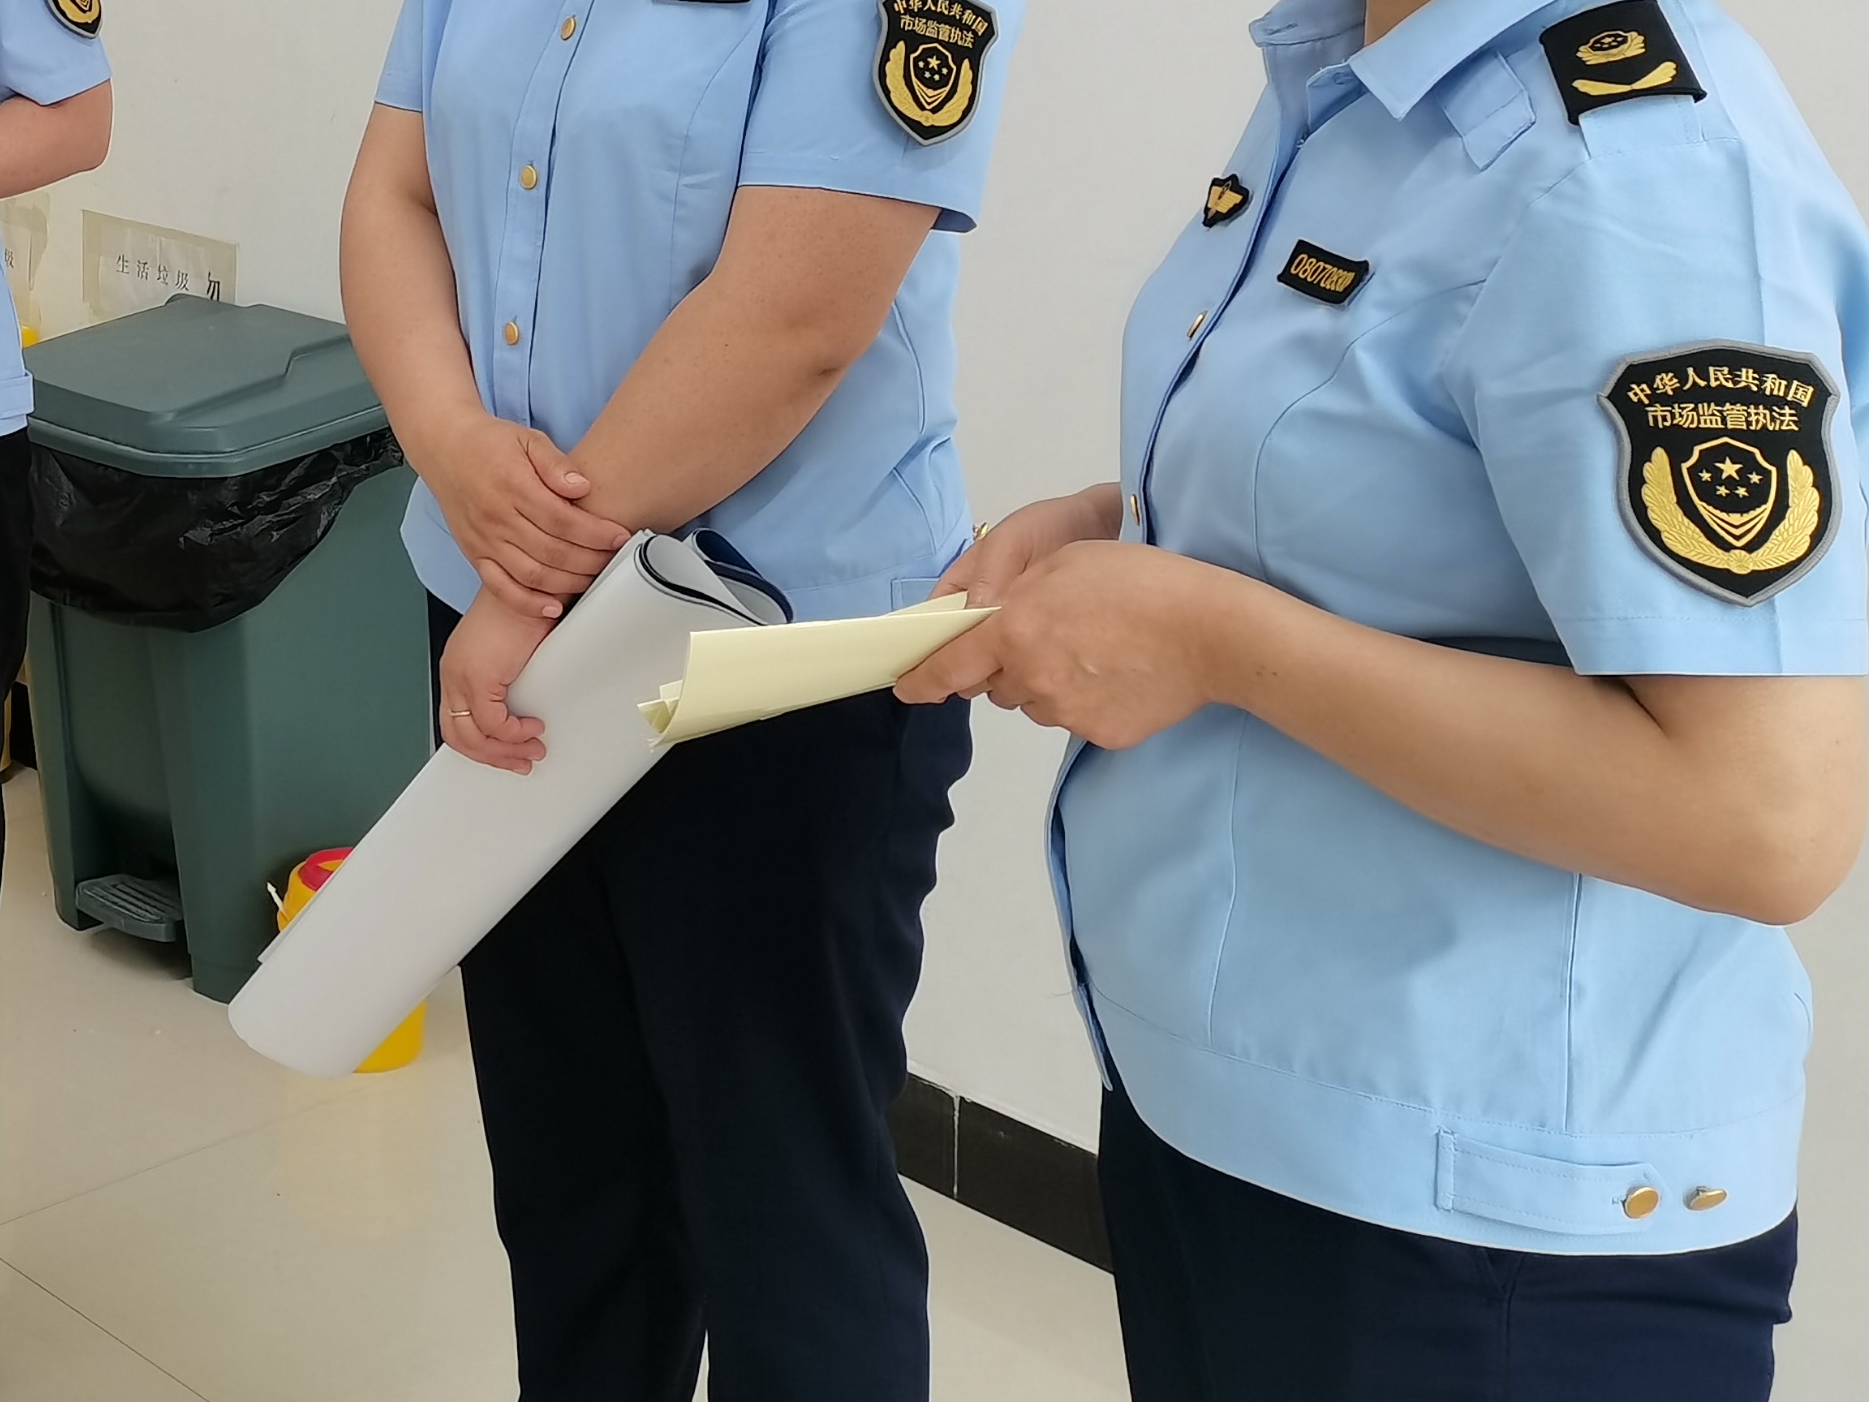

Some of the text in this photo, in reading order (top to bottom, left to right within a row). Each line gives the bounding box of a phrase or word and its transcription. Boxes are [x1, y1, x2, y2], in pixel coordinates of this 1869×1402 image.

[900, 14, 974, 48] 市场监管执法
[116, 253, 190, 292] 生活垃圾
[1627, 365, 1815, 408] 中华人民共和国
[1645, 403, 1800, 431] 市场监管执法
